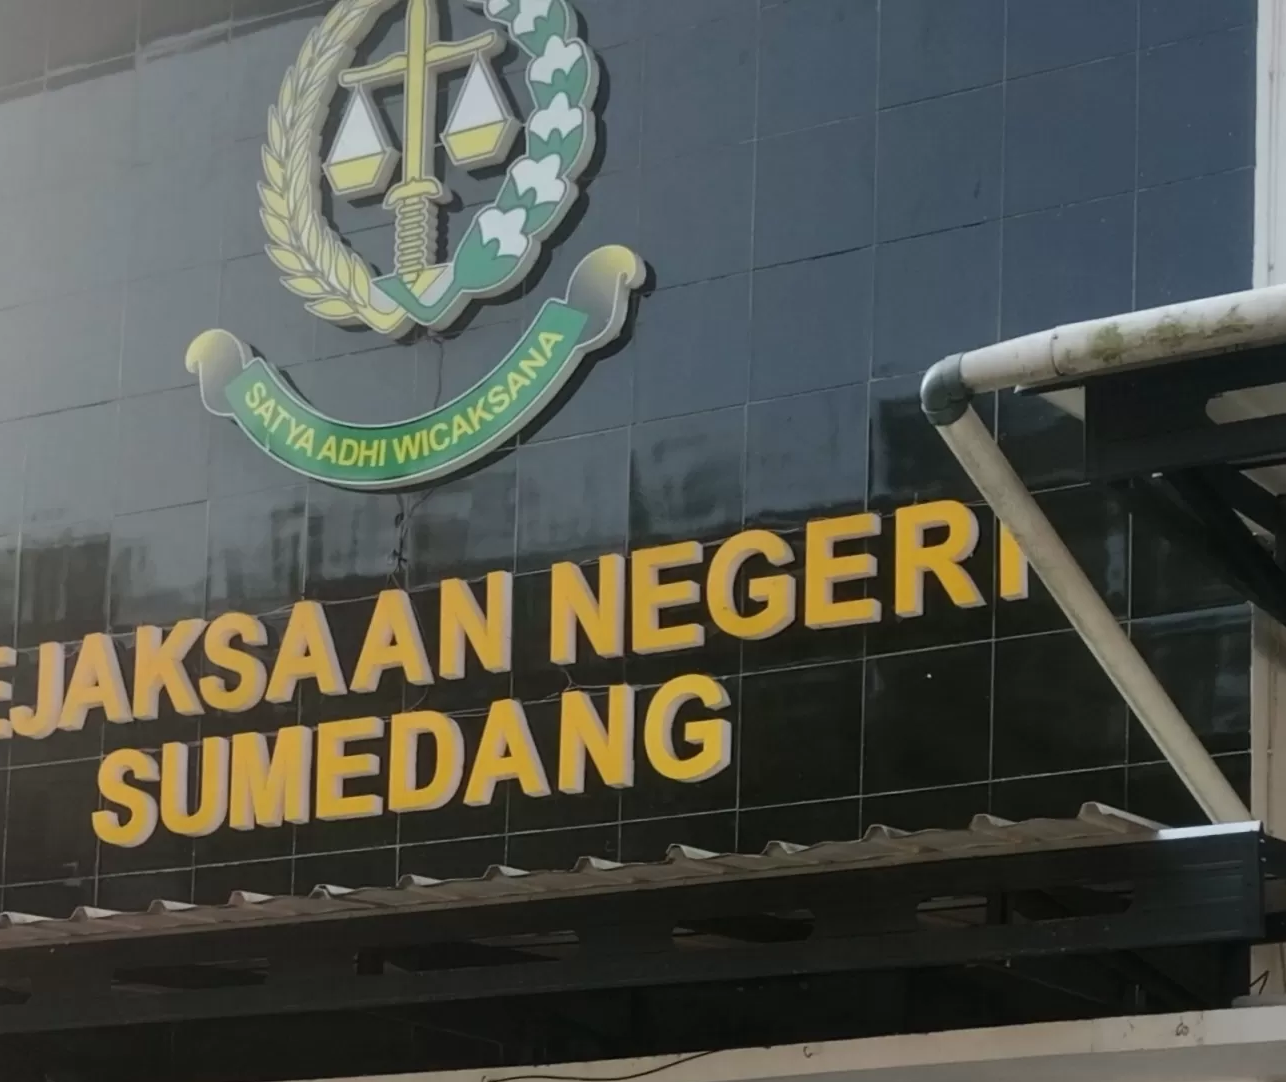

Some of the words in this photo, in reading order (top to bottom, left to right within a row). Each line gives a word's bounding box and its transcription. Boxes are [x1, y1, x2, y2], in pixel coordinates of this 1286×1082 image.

[244, 381, 315, 457] SATYA
[316, 435, 387, 468] ADHI
[392, 330, 564, 465] WICAKSANA
[549, 499, 1029, 665] NEGERI
[91, 673, 732, 848] SUMEDANG
